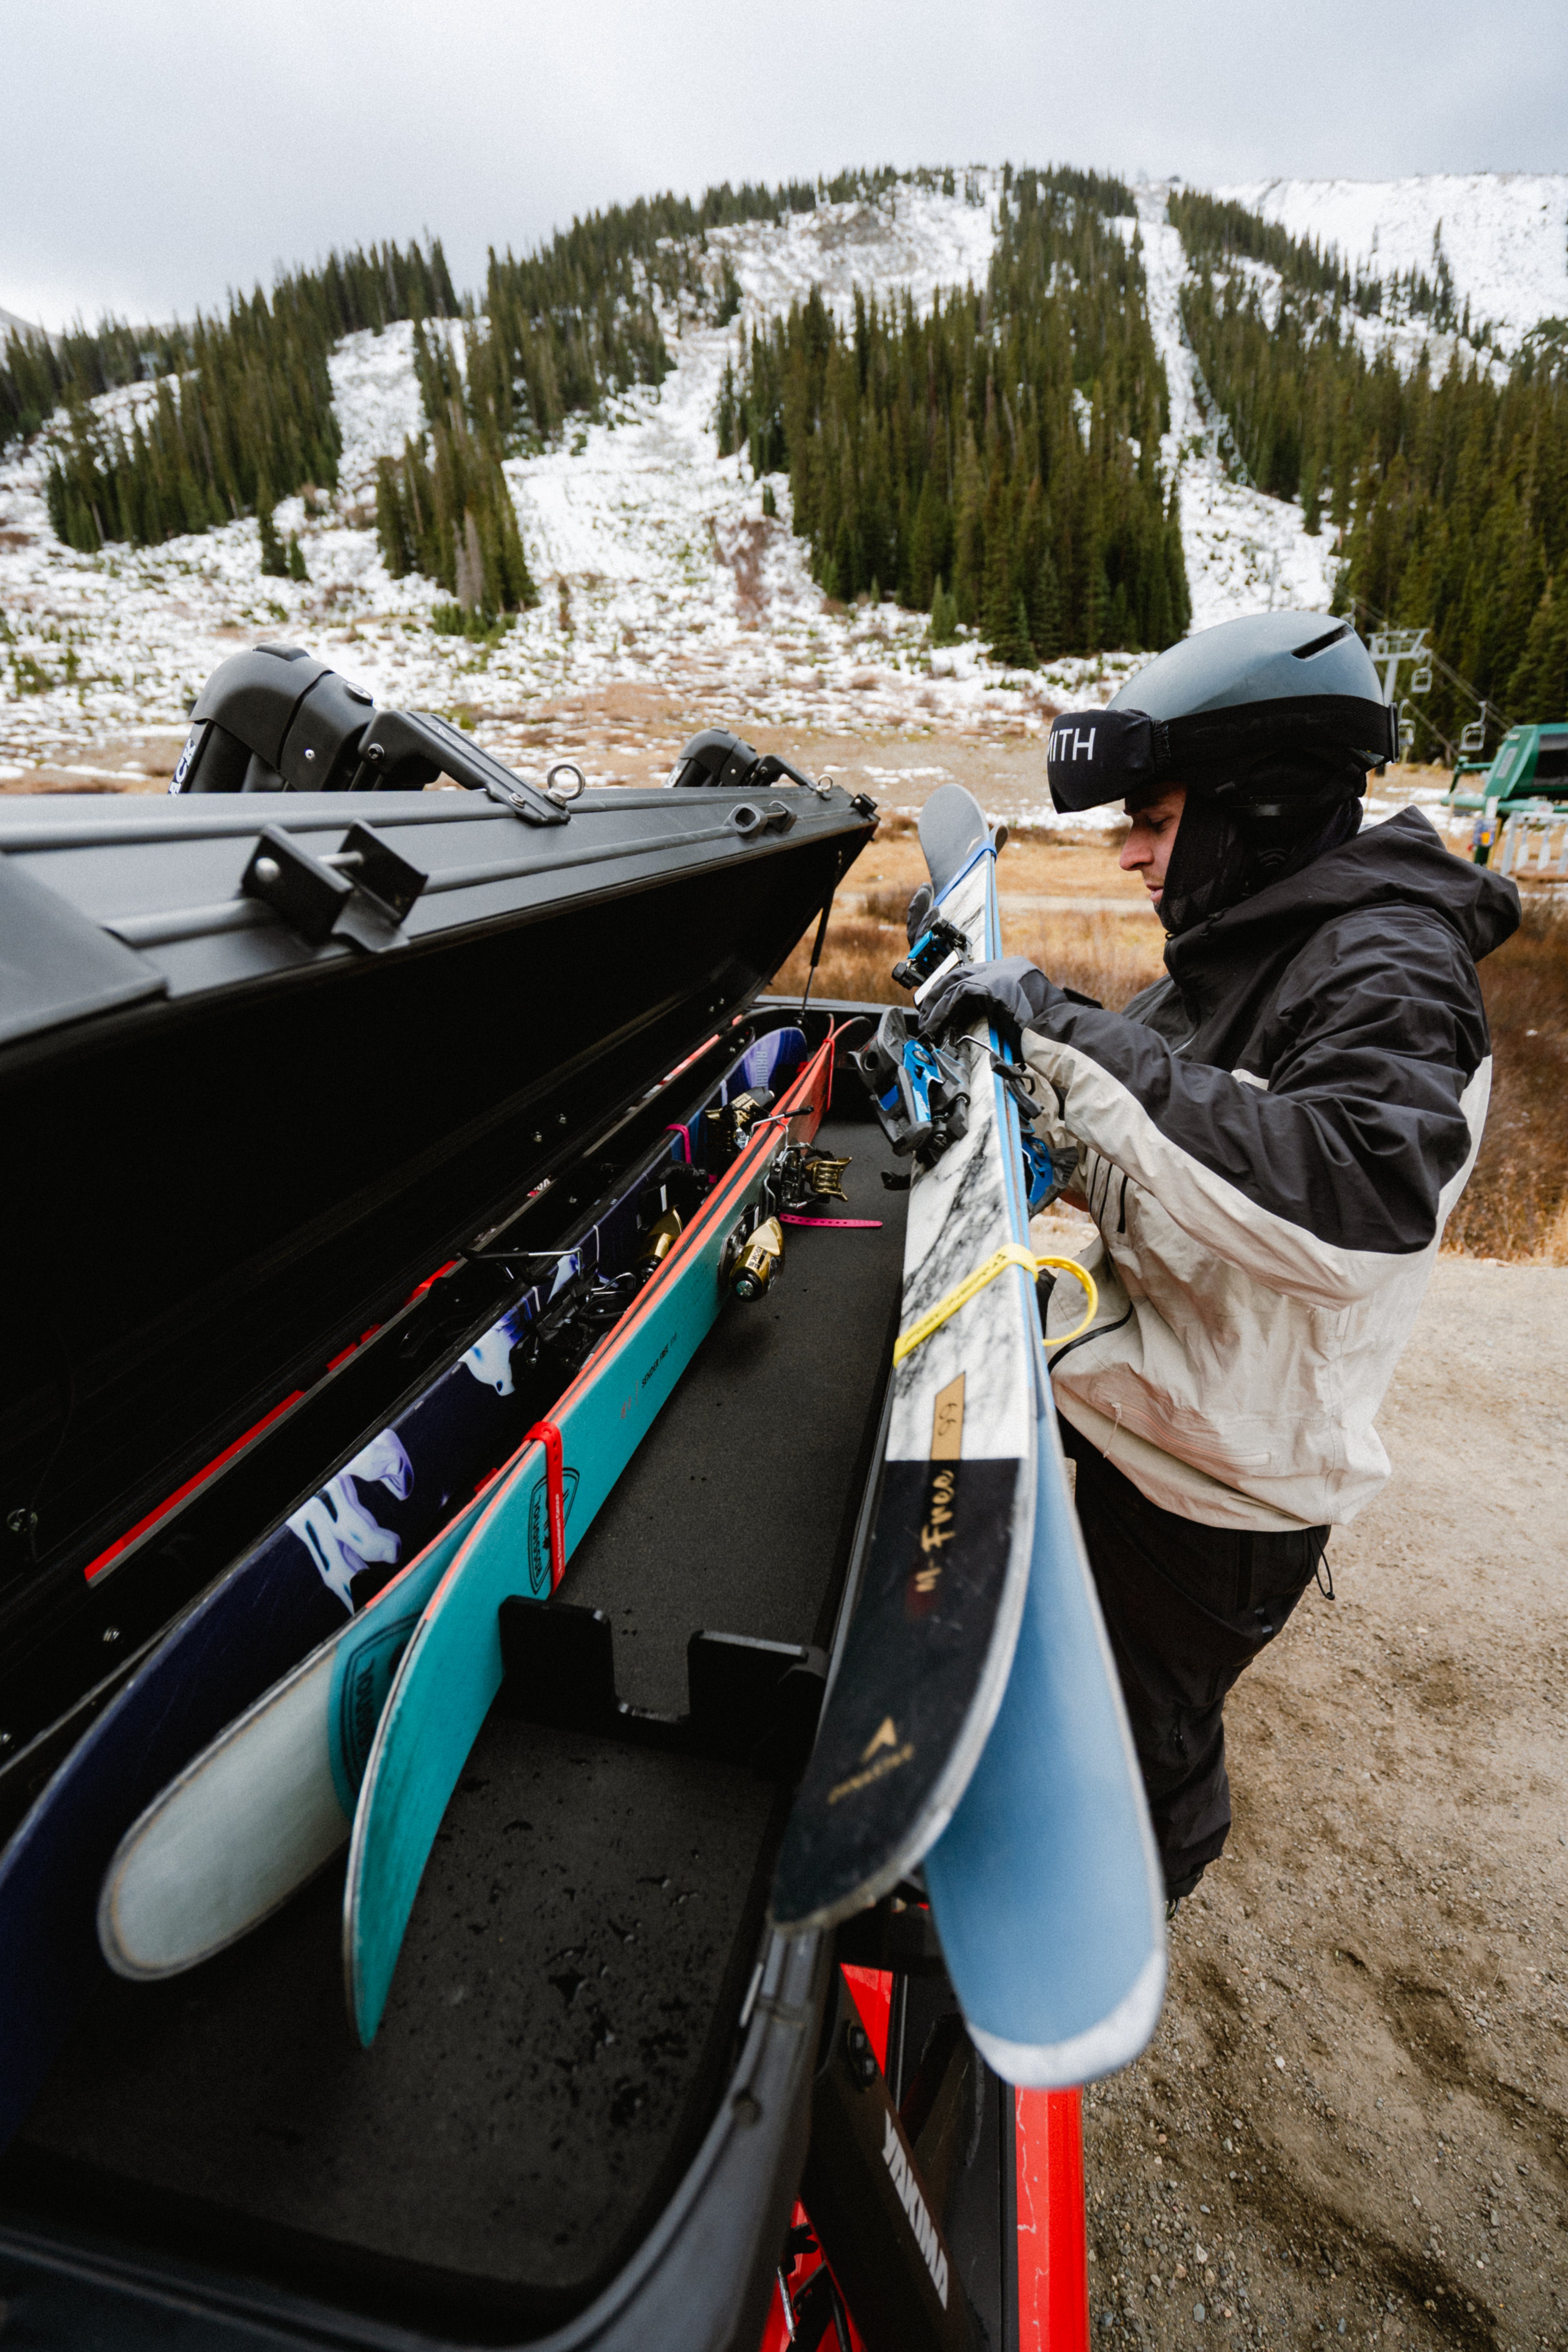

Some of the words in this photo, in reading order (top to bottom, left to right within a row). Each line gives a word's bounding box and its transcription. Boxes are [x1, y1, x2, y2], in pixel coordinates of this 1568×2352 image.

[750, 1246, 763, 1262] LOOK
[642, 1358, 659, 1388] SENDER
[659, 1343, 669, 1363] FREE
[533, 1494, 543, 1578] ROSSIGNOL
